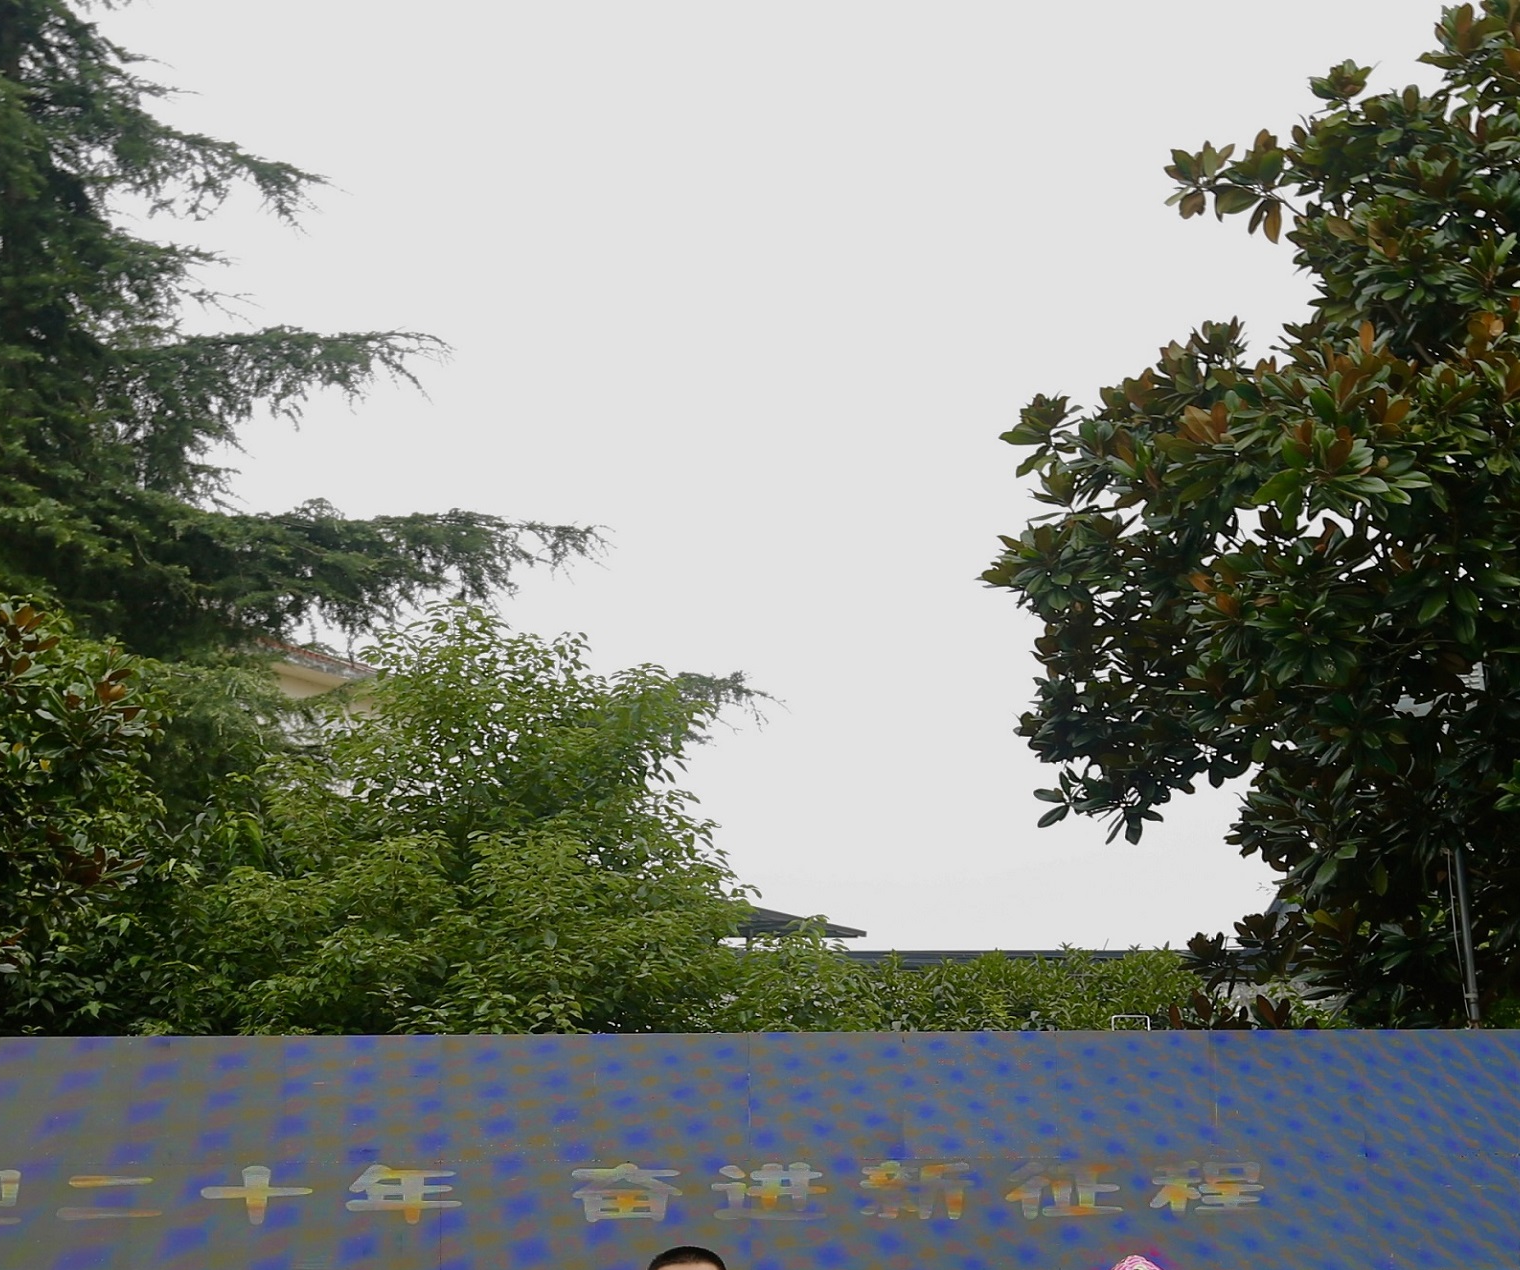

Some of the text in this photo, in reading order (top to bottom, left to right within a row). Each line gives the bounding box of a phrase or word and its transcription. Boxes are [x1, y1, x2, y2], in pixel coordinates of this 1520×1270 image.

[572, 1161, 1266, 1222] 奋进新征程
